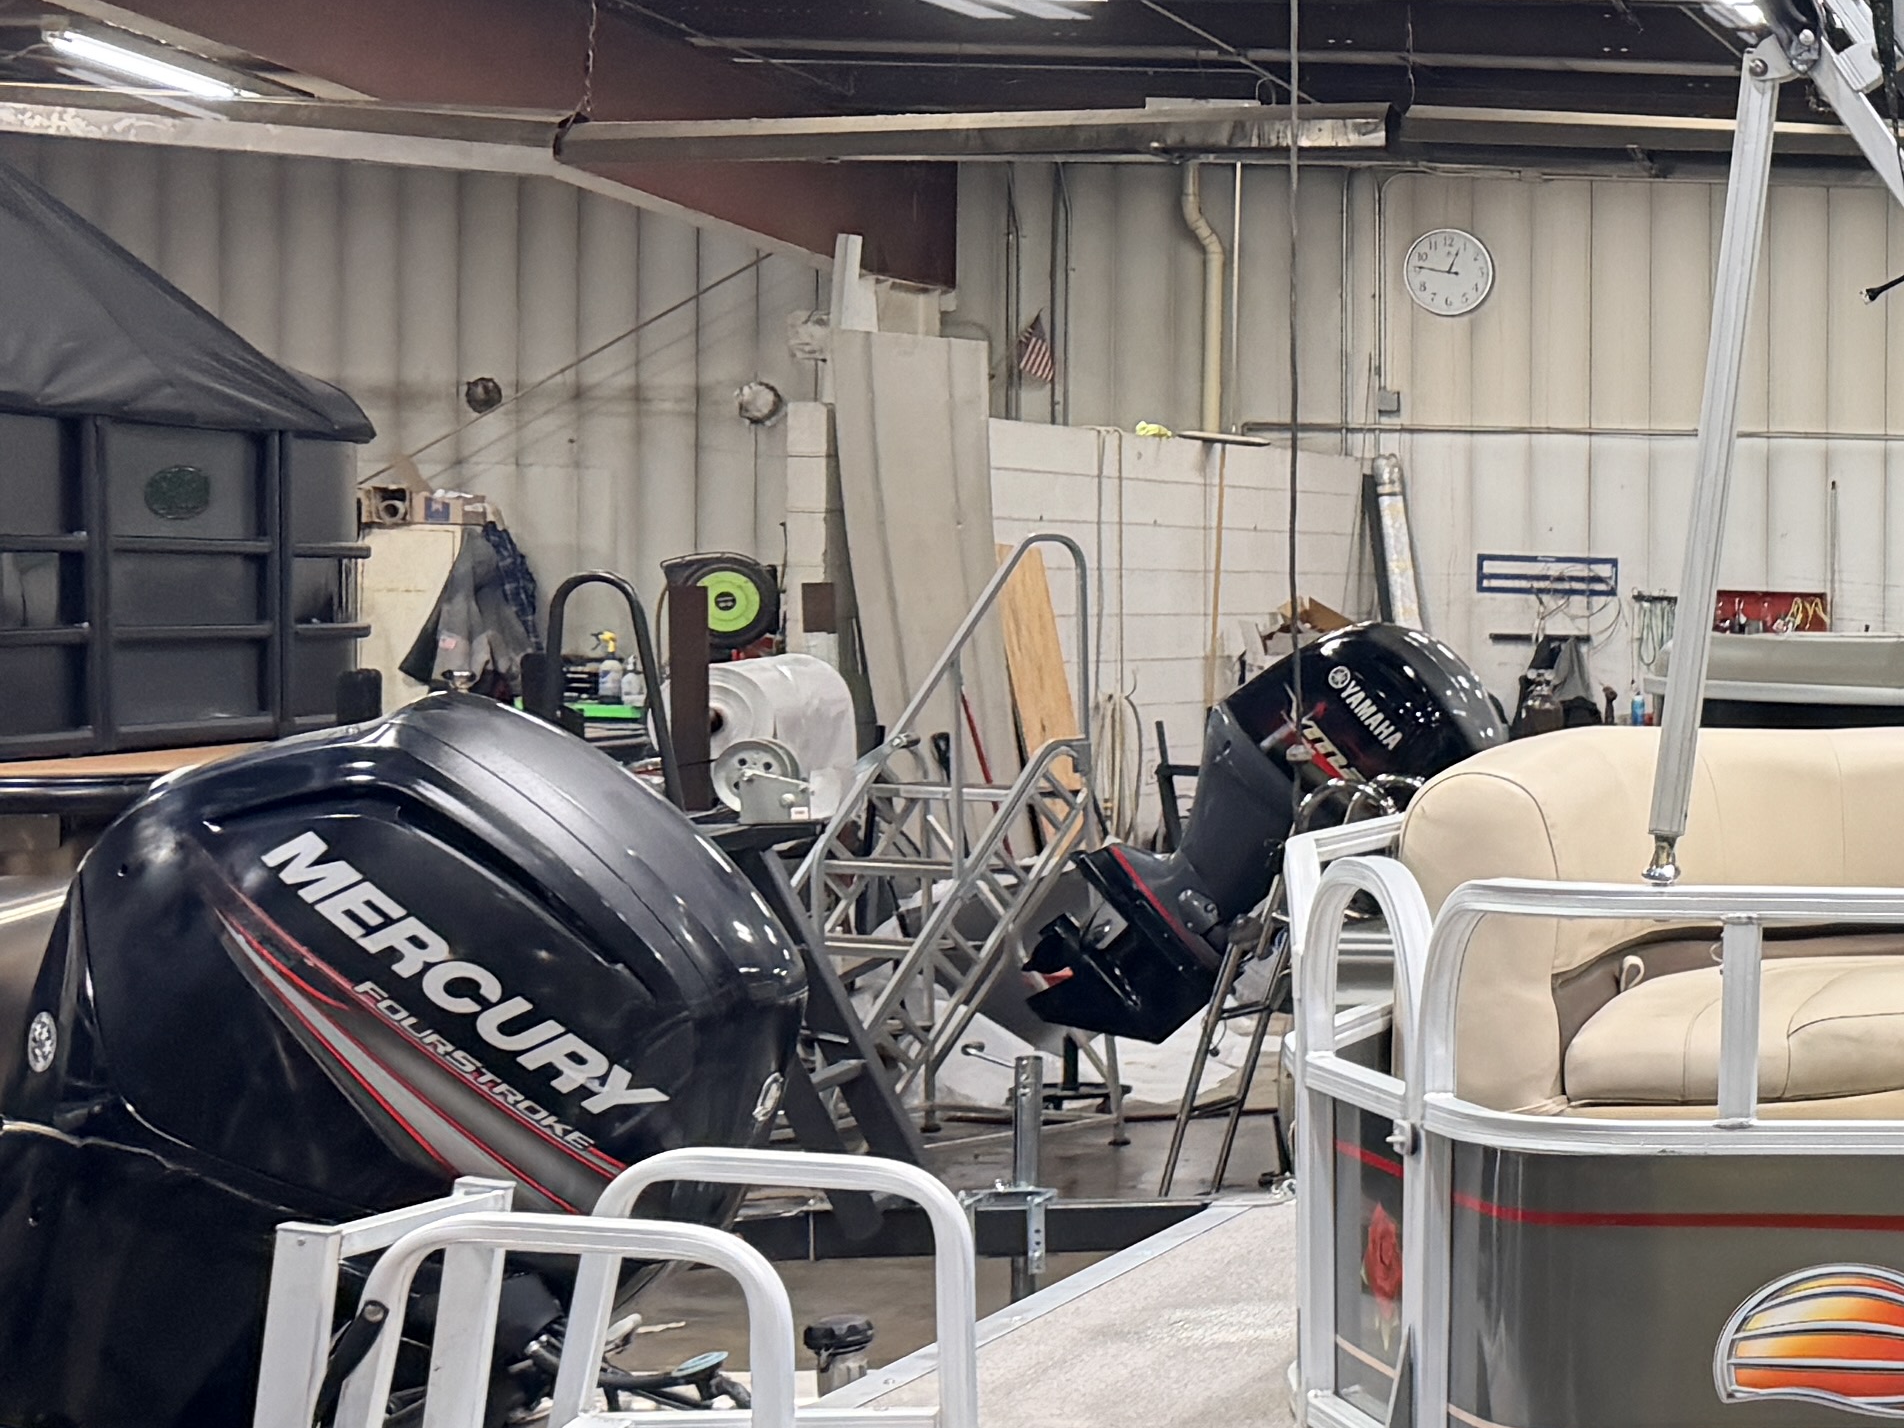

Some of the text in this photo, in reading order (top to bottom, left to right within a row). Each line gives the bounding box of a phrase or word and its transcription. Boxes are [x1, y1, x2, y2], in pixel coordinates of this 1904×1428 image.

[1417, 252, 1428, 262] 10
[1428, 238, 1438, 251] 11
[1443, 235, 1454, 247] 12
[1340, 679, 1403, 751] YAMAHA
[261, 831, 670, 1114] MERCURY
[353, 980, 596, 1150] FOURSTROKE
